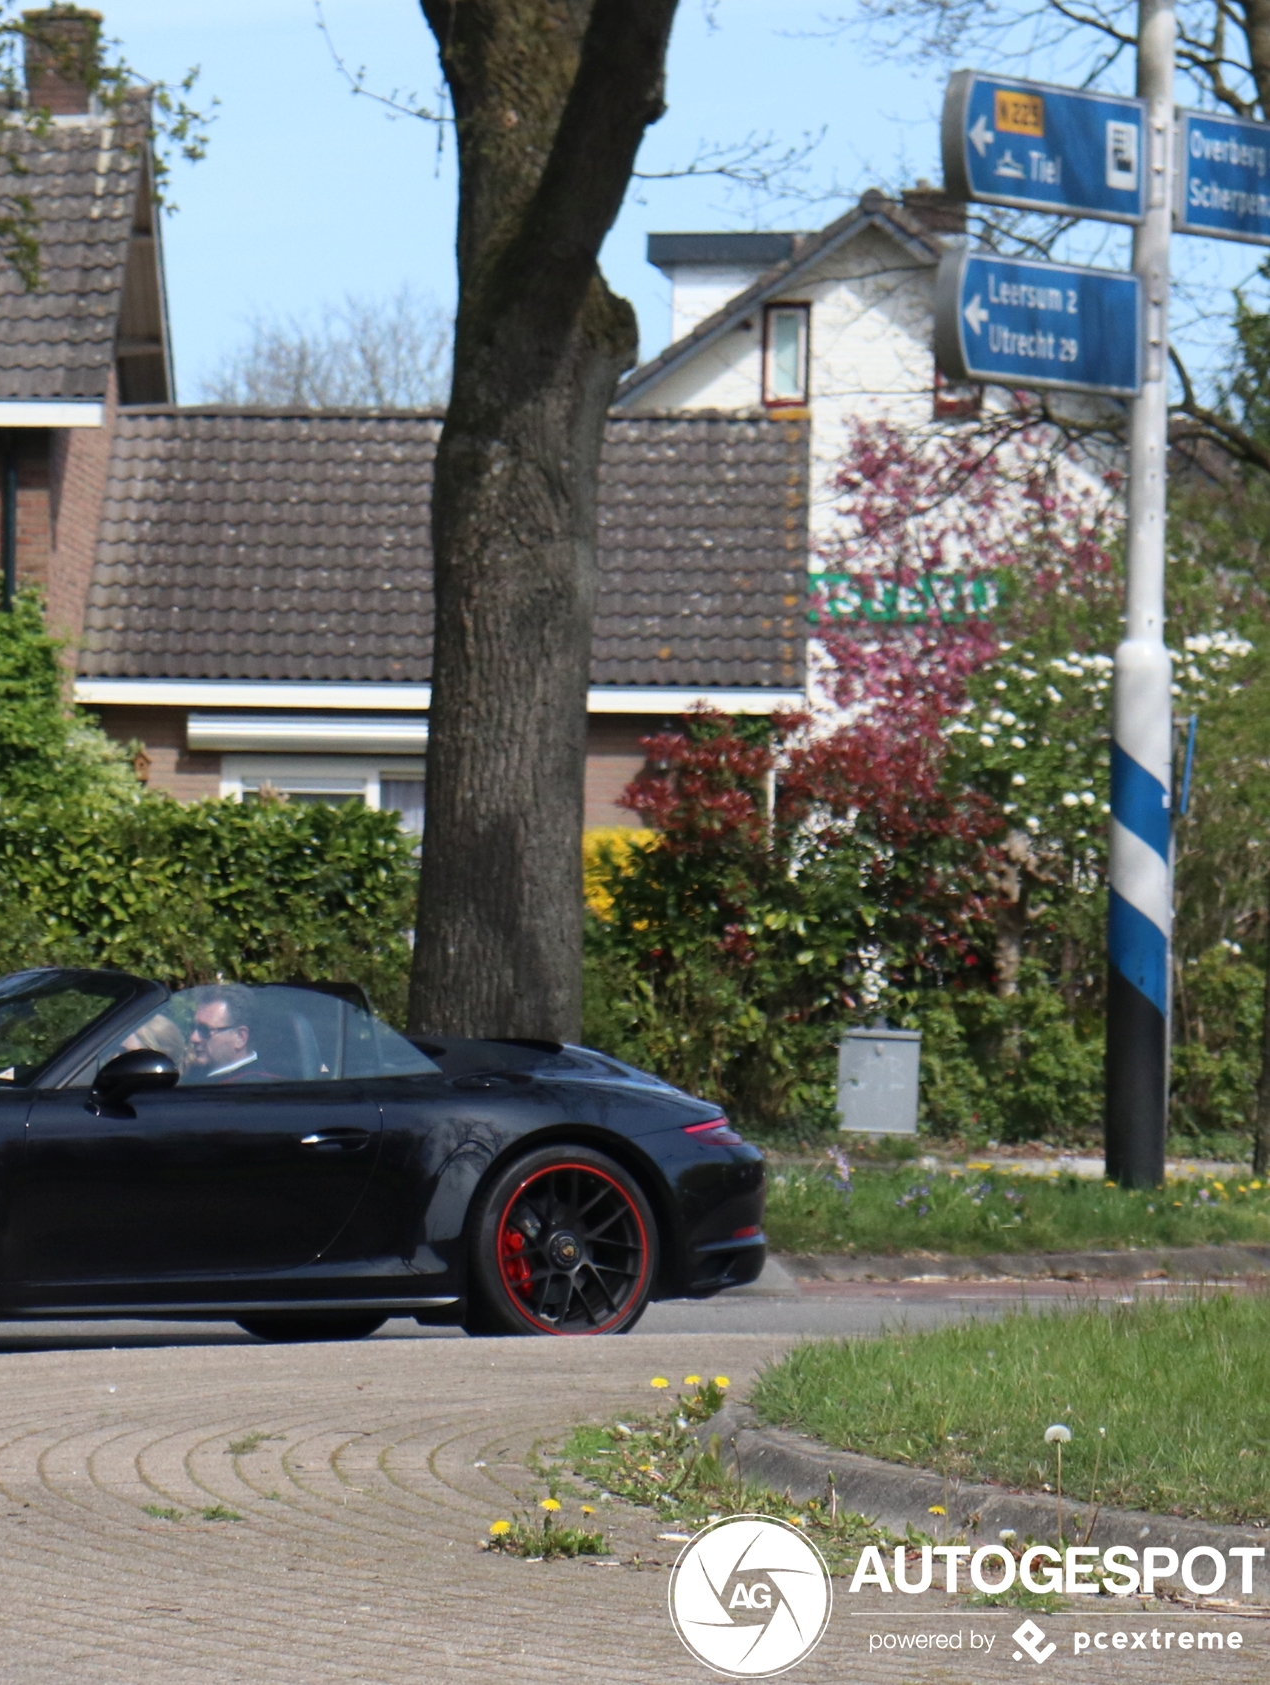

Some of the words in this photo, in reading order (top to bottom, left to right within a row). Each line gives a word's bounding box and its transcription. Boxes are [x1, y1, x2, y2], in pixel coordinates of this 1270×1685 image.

[1028, 149, 1062, 185] Tiel
[1190, 128, 1266, 177] Overberg
[988, 273, 1062, 312] Leersum
[1067, 289, 1078, 314] 2
[988, 323, 1055, 358] Utrecht
[1059, 339, 1078, 363] 29
